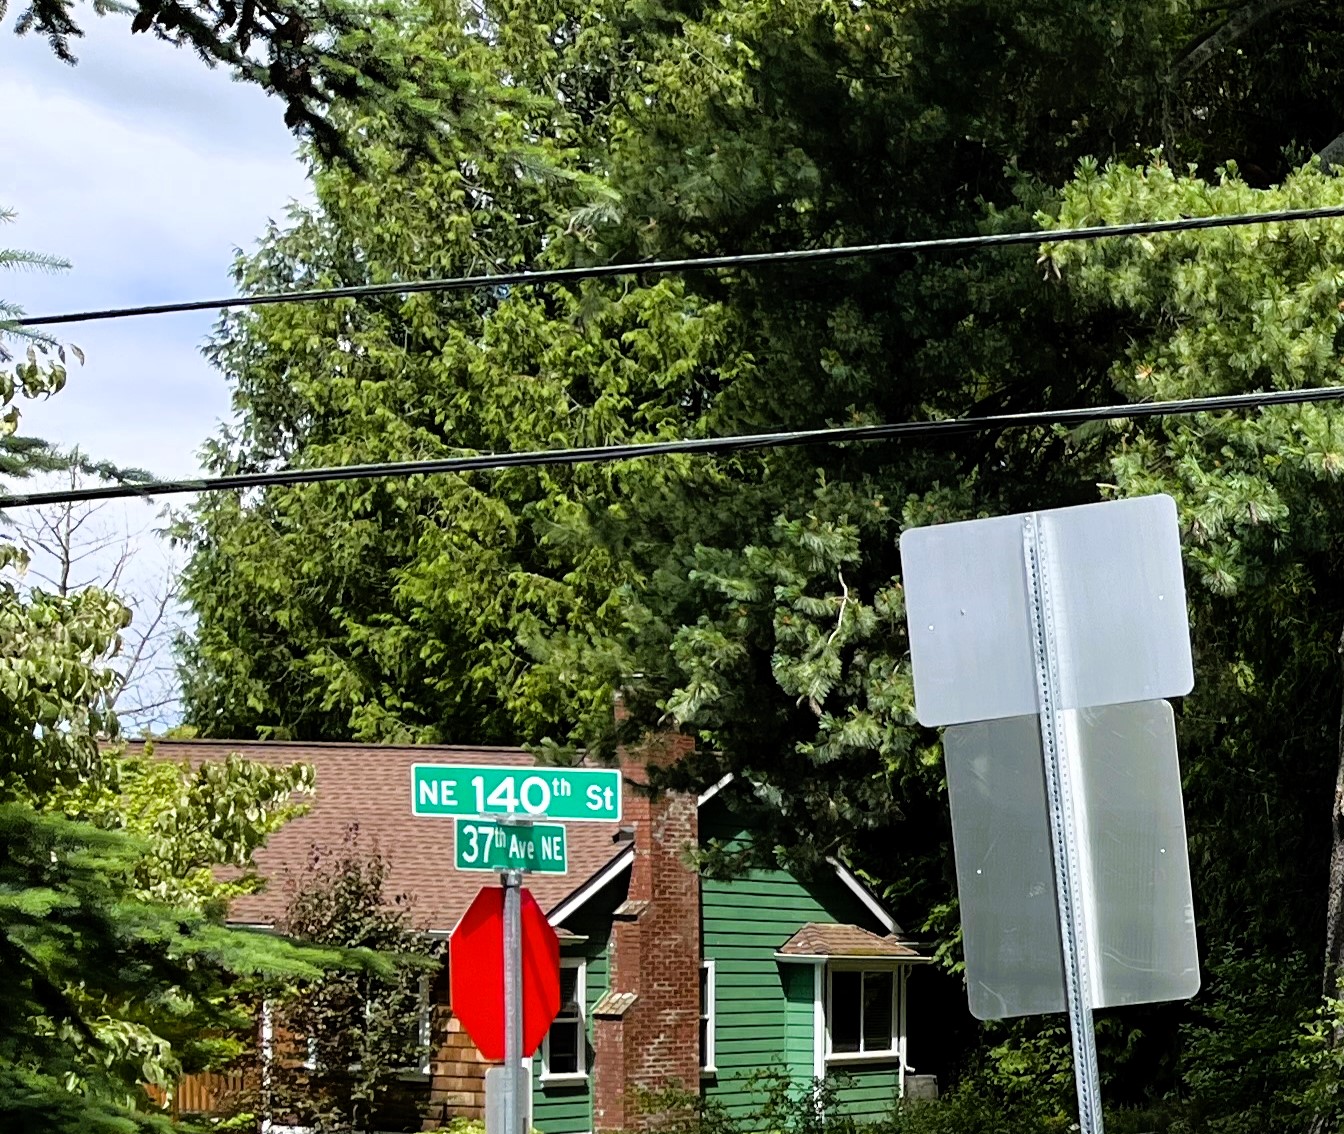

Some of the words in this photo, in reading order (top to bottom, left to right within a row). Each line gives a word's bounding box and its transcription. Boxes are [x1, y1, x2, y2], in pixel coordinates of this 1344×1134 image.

[419, 780, 458, 806] NE
[471, 776, 572, 814] 140th
[585, 784, 615, 811] St
[462, 825, 507, 863] 37th
[508, 834, 535, 859] Ave
[541, 836, 563, 860] NE
